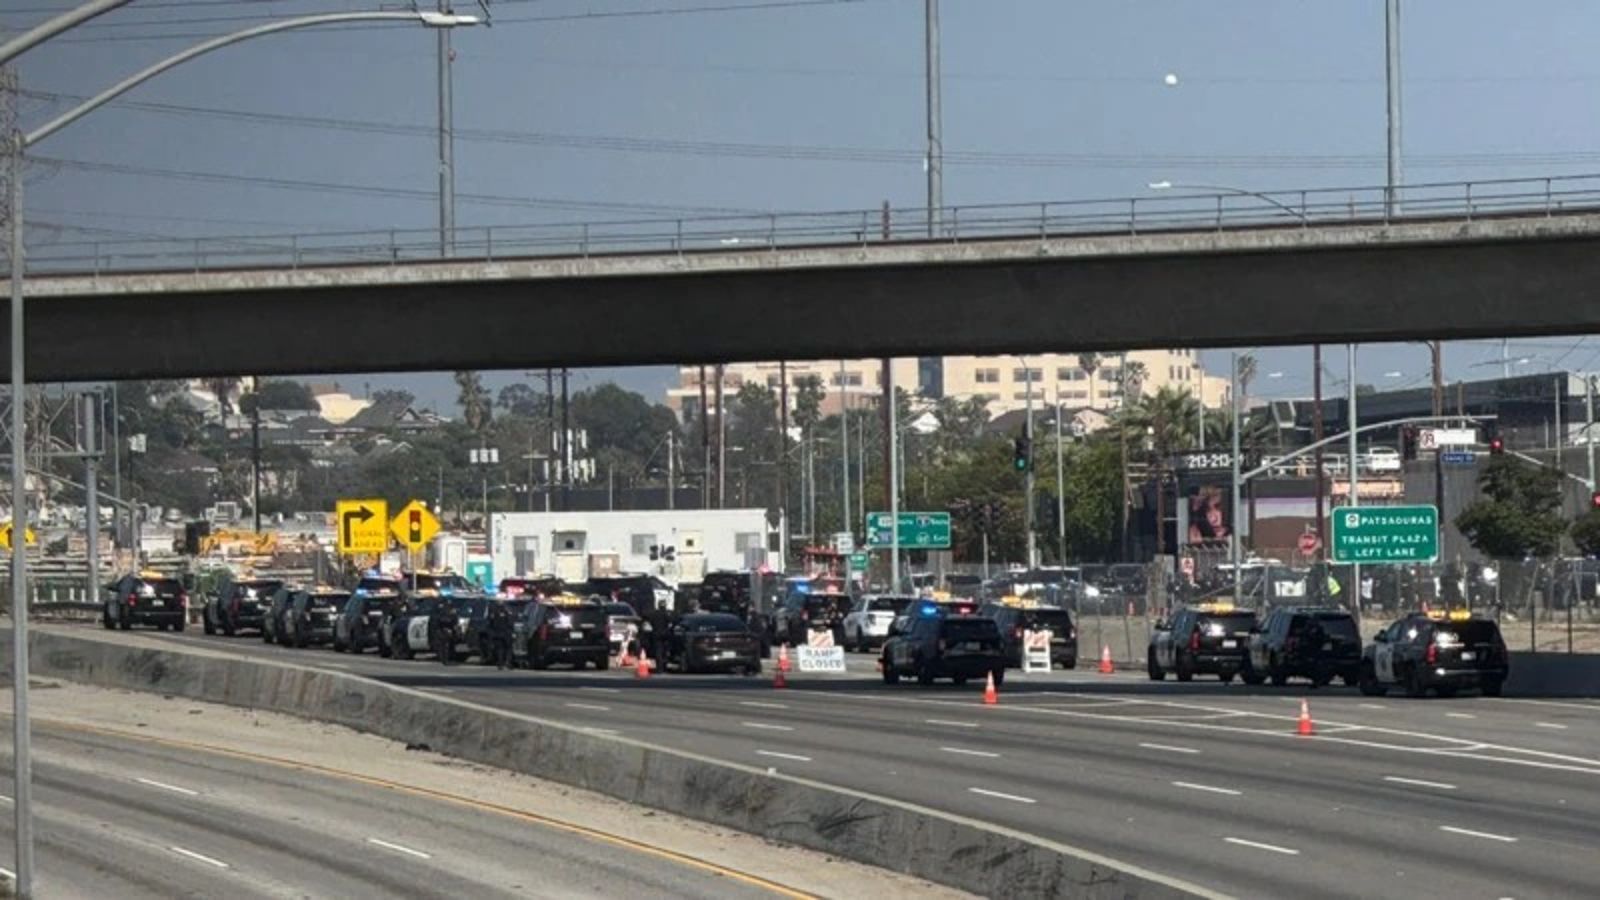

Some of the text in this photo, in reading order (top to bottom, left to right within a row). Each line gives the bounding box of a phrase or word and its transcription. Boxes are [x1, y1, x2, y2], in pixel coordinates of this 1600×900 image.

[1361, 515, 1433, 525] PATSAOURAS
[1341, 534, 1429, 544] TRANSIT PLAZA
[1354, 548, 1383, 557] LEFT
[1386, 548, 1416, 556] LANE
[805, 649, 838, 657] RAMP
[801, 659, 841, 668] CLOSED
